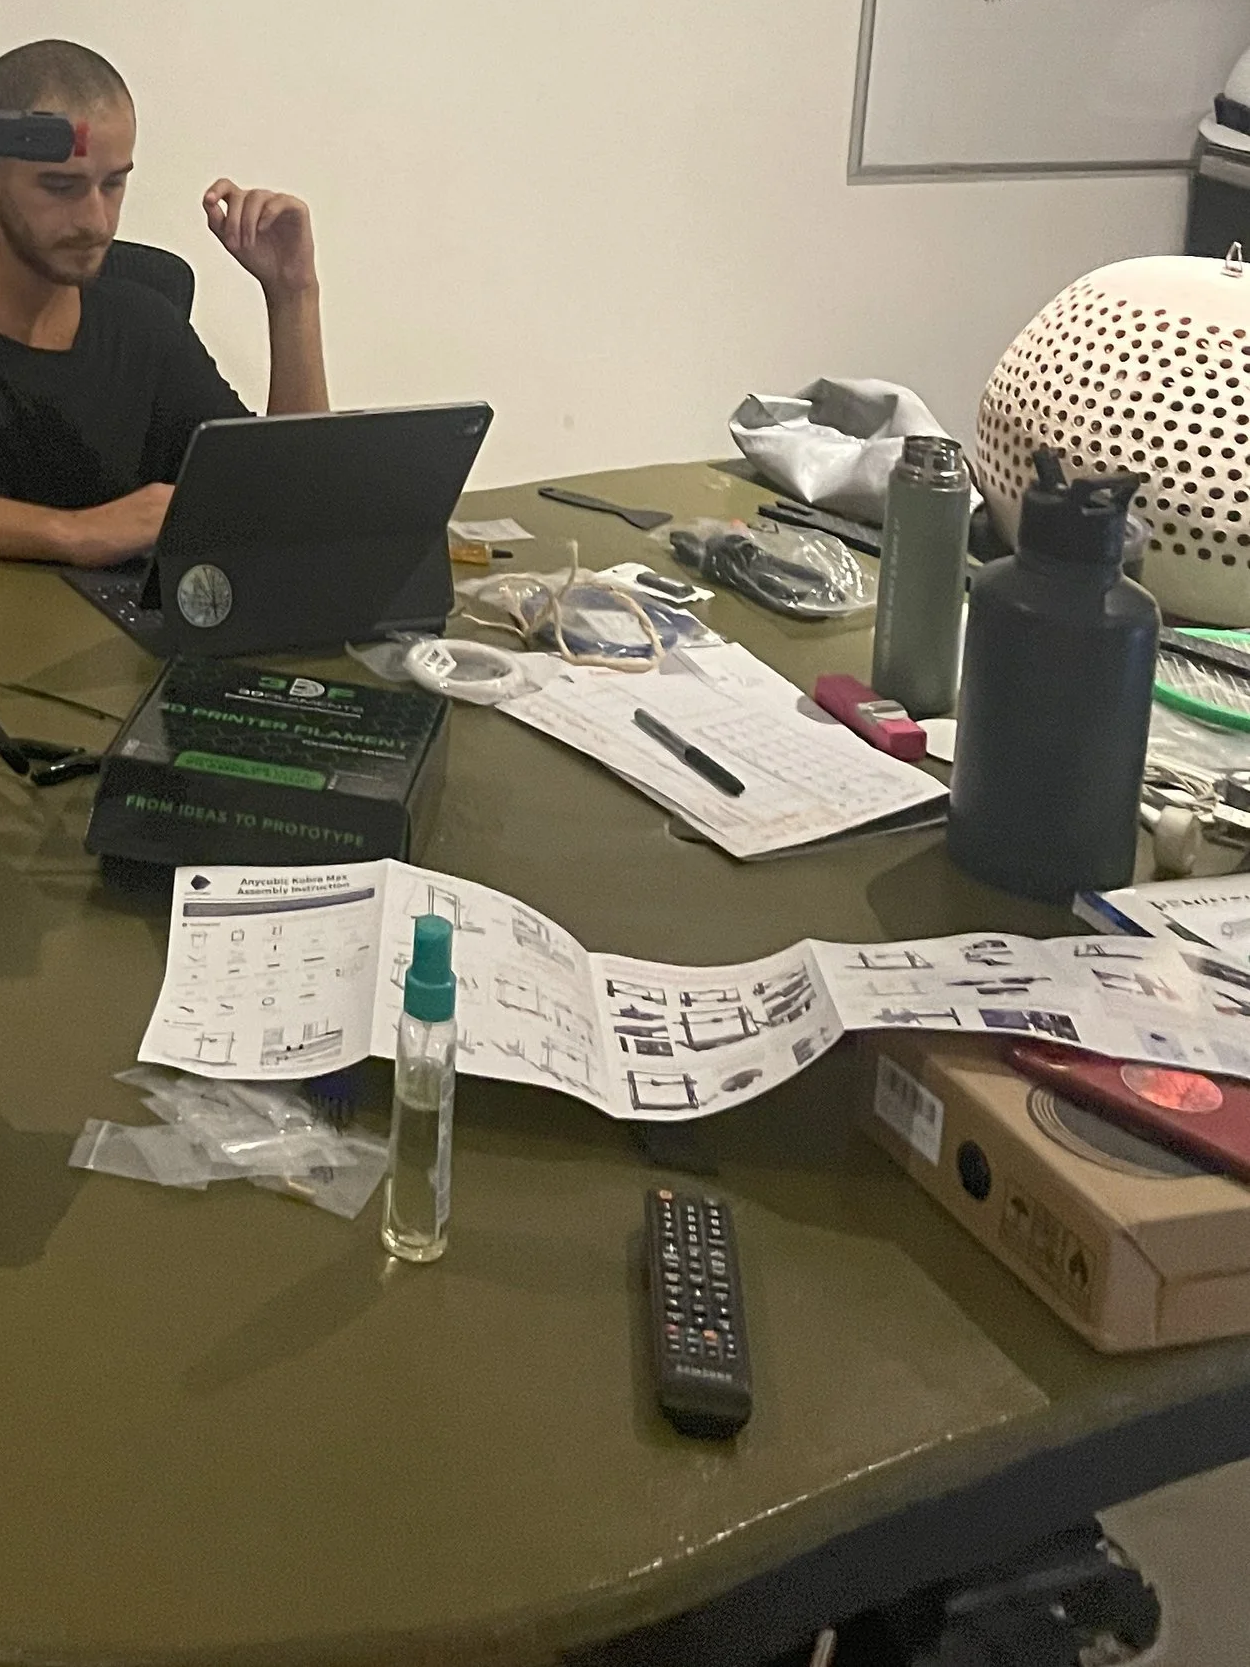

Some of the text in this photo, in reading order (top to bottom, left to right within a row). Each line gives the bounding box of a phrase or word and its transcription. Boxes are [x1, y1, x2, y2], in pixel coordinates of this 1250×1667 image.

[192, 707, 288, 731] PRINTER
[294, 724, 406, 750] FILAMENT
[125, 794, 365, 847] FROM IDEAS TO PROTOTYPE
[237, 882, 350, 895] Assembly Instruction
[240, 877, 289, 887] Anycubic
[292, 875, 324, 884] Kobra
